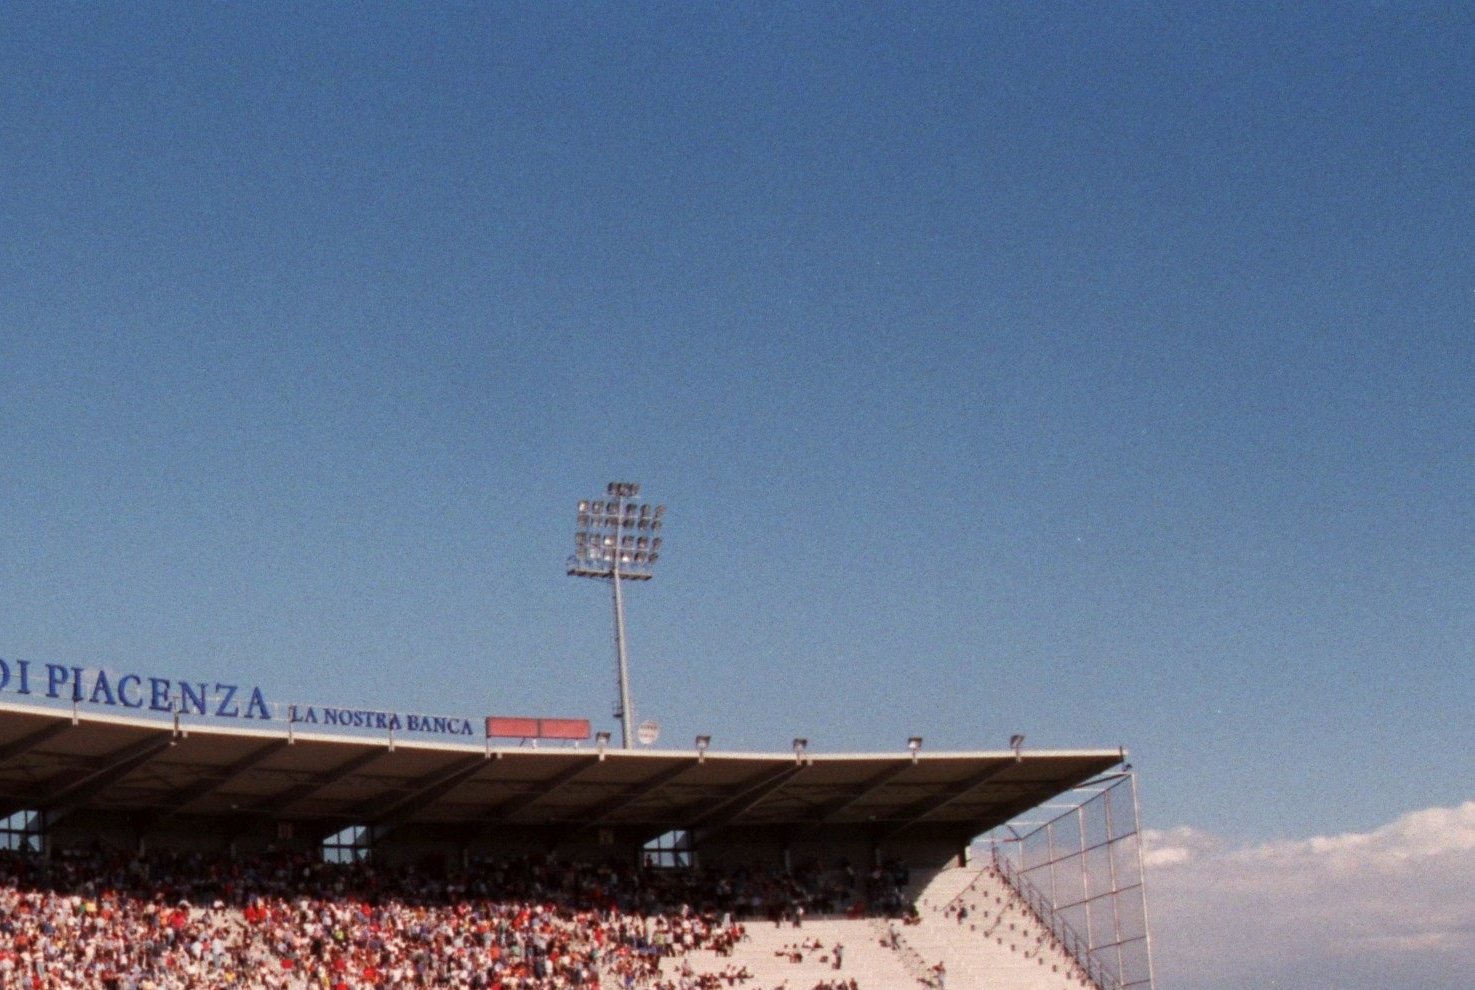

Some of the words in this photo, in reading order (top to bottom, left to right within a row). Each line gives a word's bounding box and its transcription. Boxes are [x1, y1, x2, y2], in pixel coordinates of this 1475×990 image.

[45, 663, 272, 720] PIACENZA
[291, 705, 317, 723] LA
[323, 708, 402, 731] NOSTRA
[407, 714, 474, 735] BANCA
